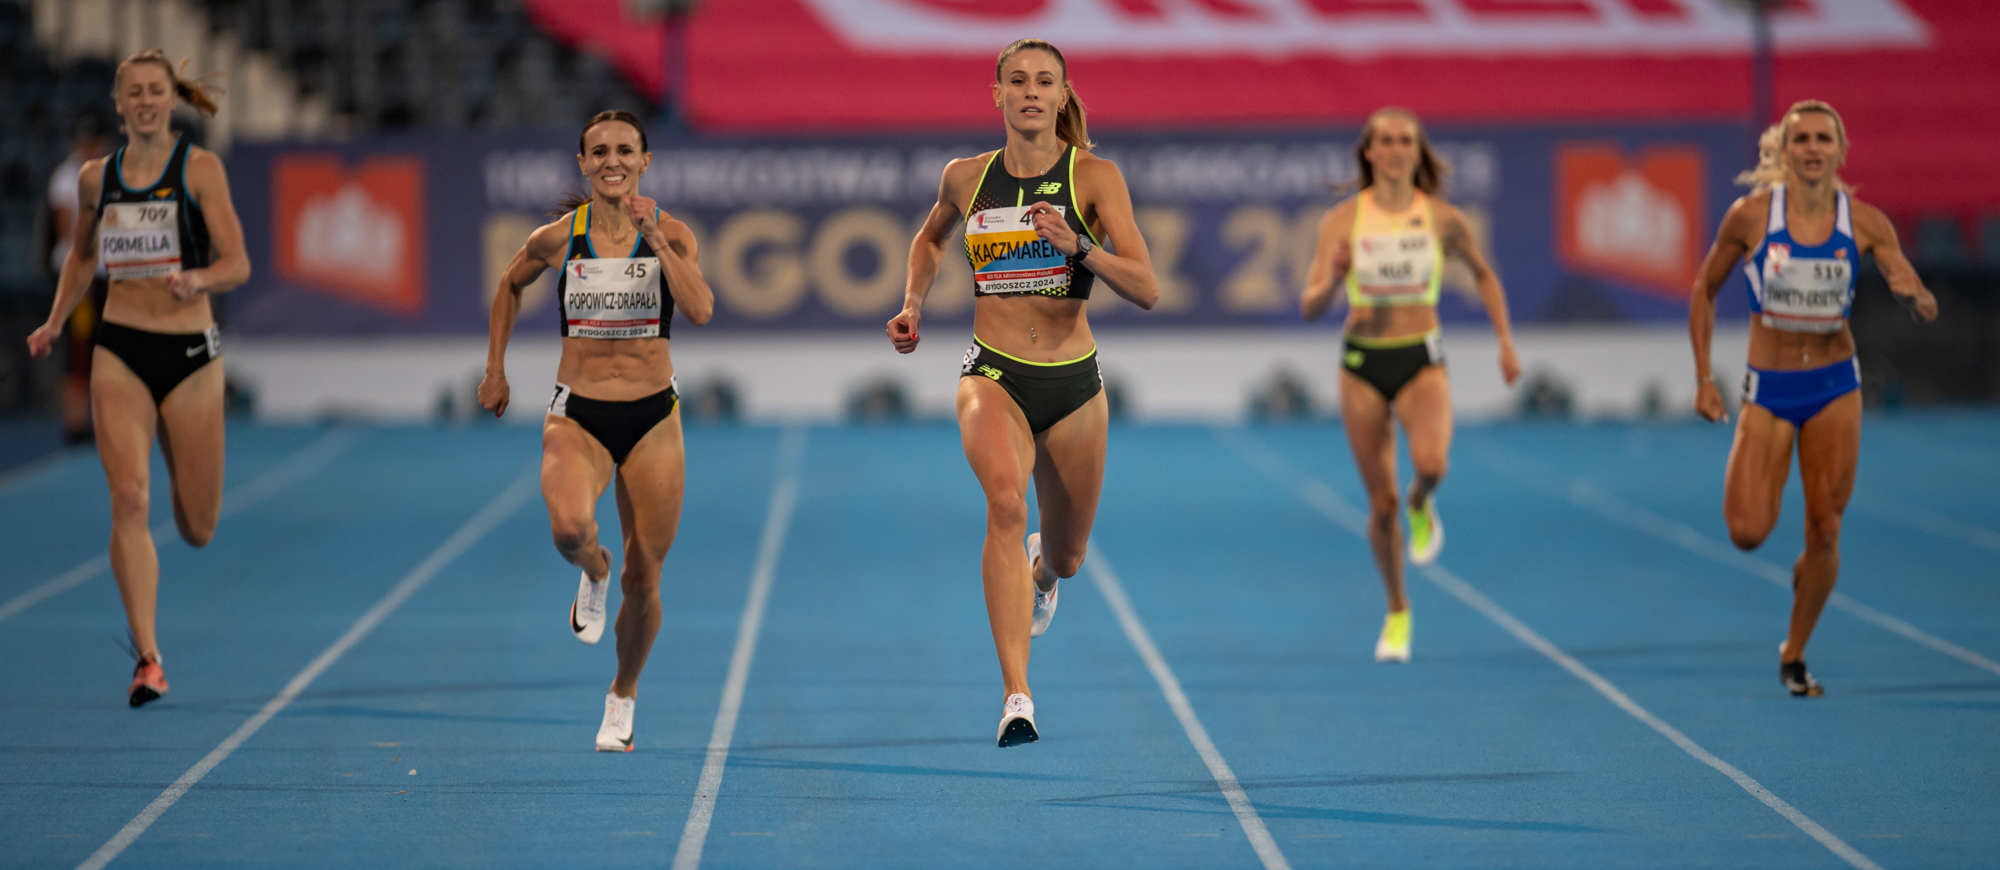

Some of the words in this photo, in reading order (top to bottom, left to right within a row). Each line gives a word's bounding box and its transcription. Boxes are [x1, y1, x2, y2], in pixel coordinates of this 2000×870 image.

[138, 206, 169, 222] 709
[103, 234, 171, 254] FORMELLA
[624, 263, 647, 278] 45
[1037, 269, 1053, 277] Polski
[1033, 278, 1055, 288] 2024
[569, 292, 657, 311] POPOWICZ-DRAPAŁA
[578, 328, 627, 337] BYDGOSZCZ
[629, 328, 648, 336] 2024
[550, 384, 564, 412] 7
